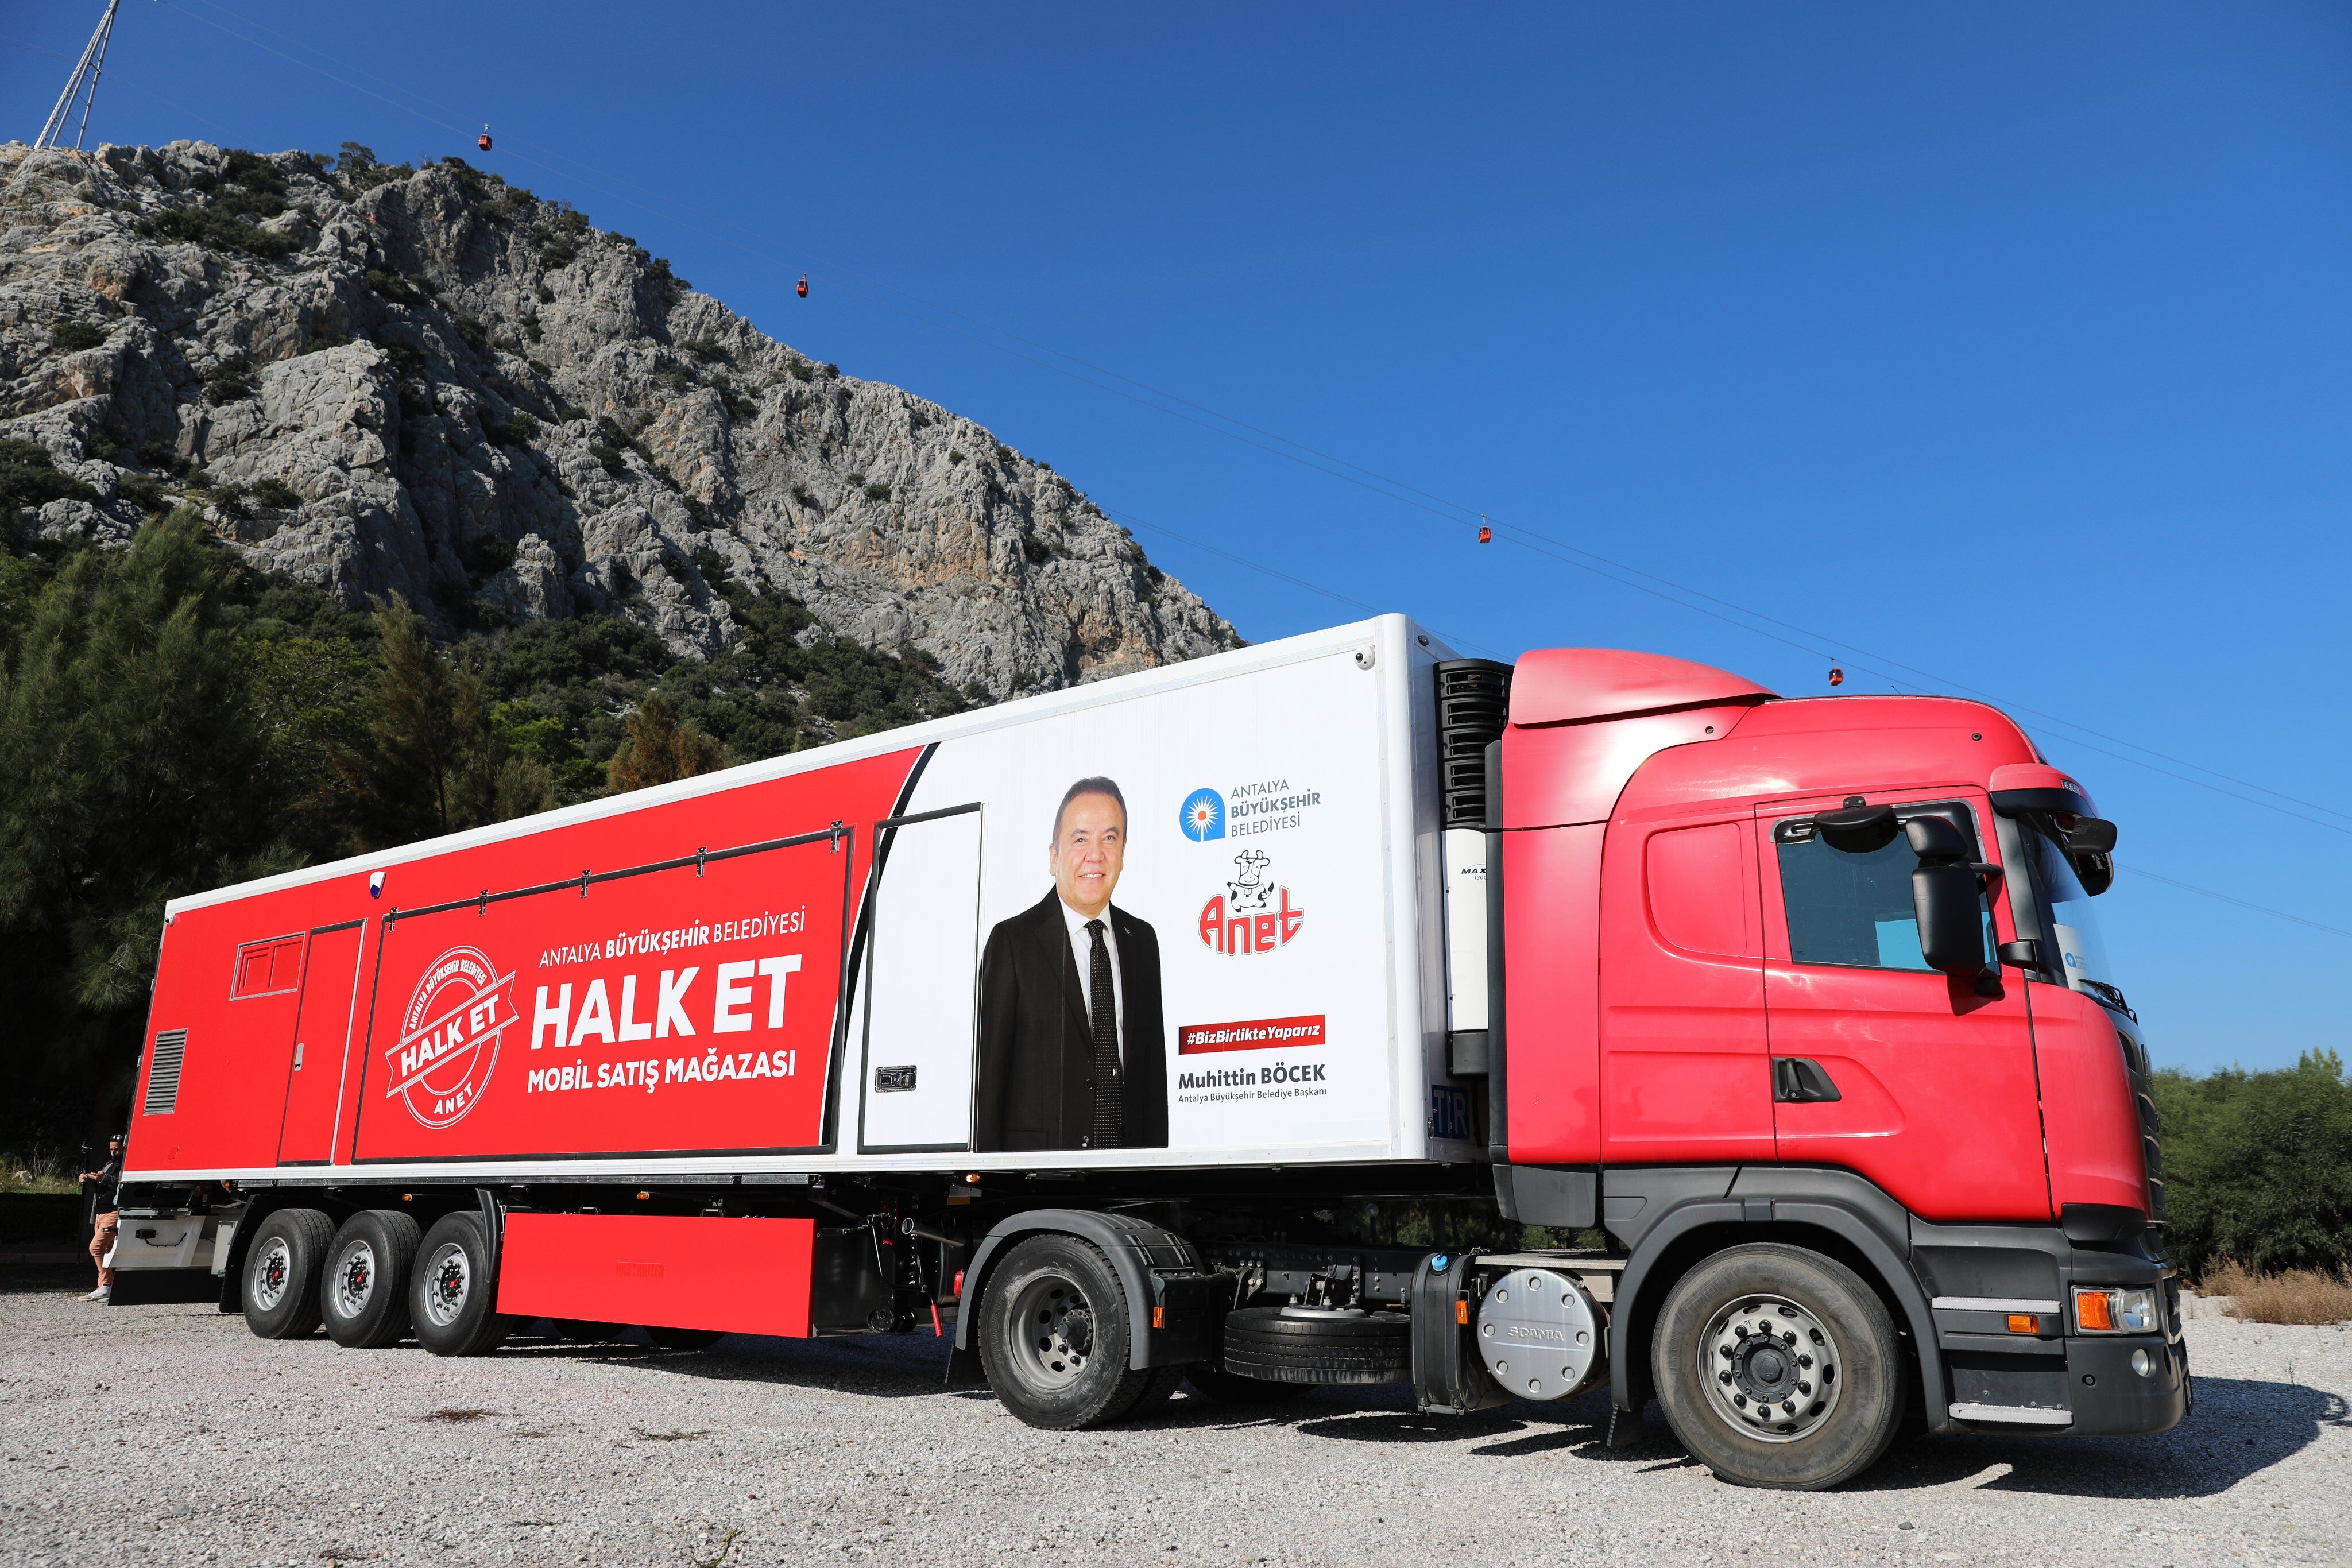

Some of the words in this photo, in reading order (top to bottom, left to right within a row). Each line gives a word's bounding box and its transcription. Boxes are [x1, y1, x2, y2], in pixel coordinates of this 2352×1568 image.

[1231, 779, 1290, 800] ANTALYA
[1231, 788, 1321, 818] BÜYÜKŞEHİR
[1231, 811, 1301, 837] BELEDİYESİ
[539, 942, 601, 969] ANTALYA
[605, 919, 710, 959] BÜYÜKŞEHİR
[713, 905, 806, 943] BELEDİYESİ
[1199, 886, 1303, 955] Anet
[409, 990, 429, 1030] ANTALYA
[531, 966, 701, 1050] HALK
[713, 954, 802, 1034] ET
[401, 1015, 465, 1078] HALK
[470, 993, 499, 1036] ET
[1186, 1025, 1320, 1045] #BizBirlikteYaparız
[527, 1058, 593, 1093] MOBİL
[596, 1059, 659, 1094] SATIŞ
[664, 1047, 796, 1083] MAĞAZASI
[1178, 1067, 1256, 1089] Muhittin
[1260, 1061, 1326, 1085] BÖCEK
[434, 1081, 473, 1115] ANET
[1178, 1093, 1208, 1104] Antalya
[1210, 1091, 1255, 1103] Büyükşehir
[1257, 1089, 1293, 1100] Belediye
[1294, 1087, 1327, 1098] Başkanı
[1433, 1089, 1468, 1135] TIR
[1507, 1326, 1564, 1342] SCANIA
